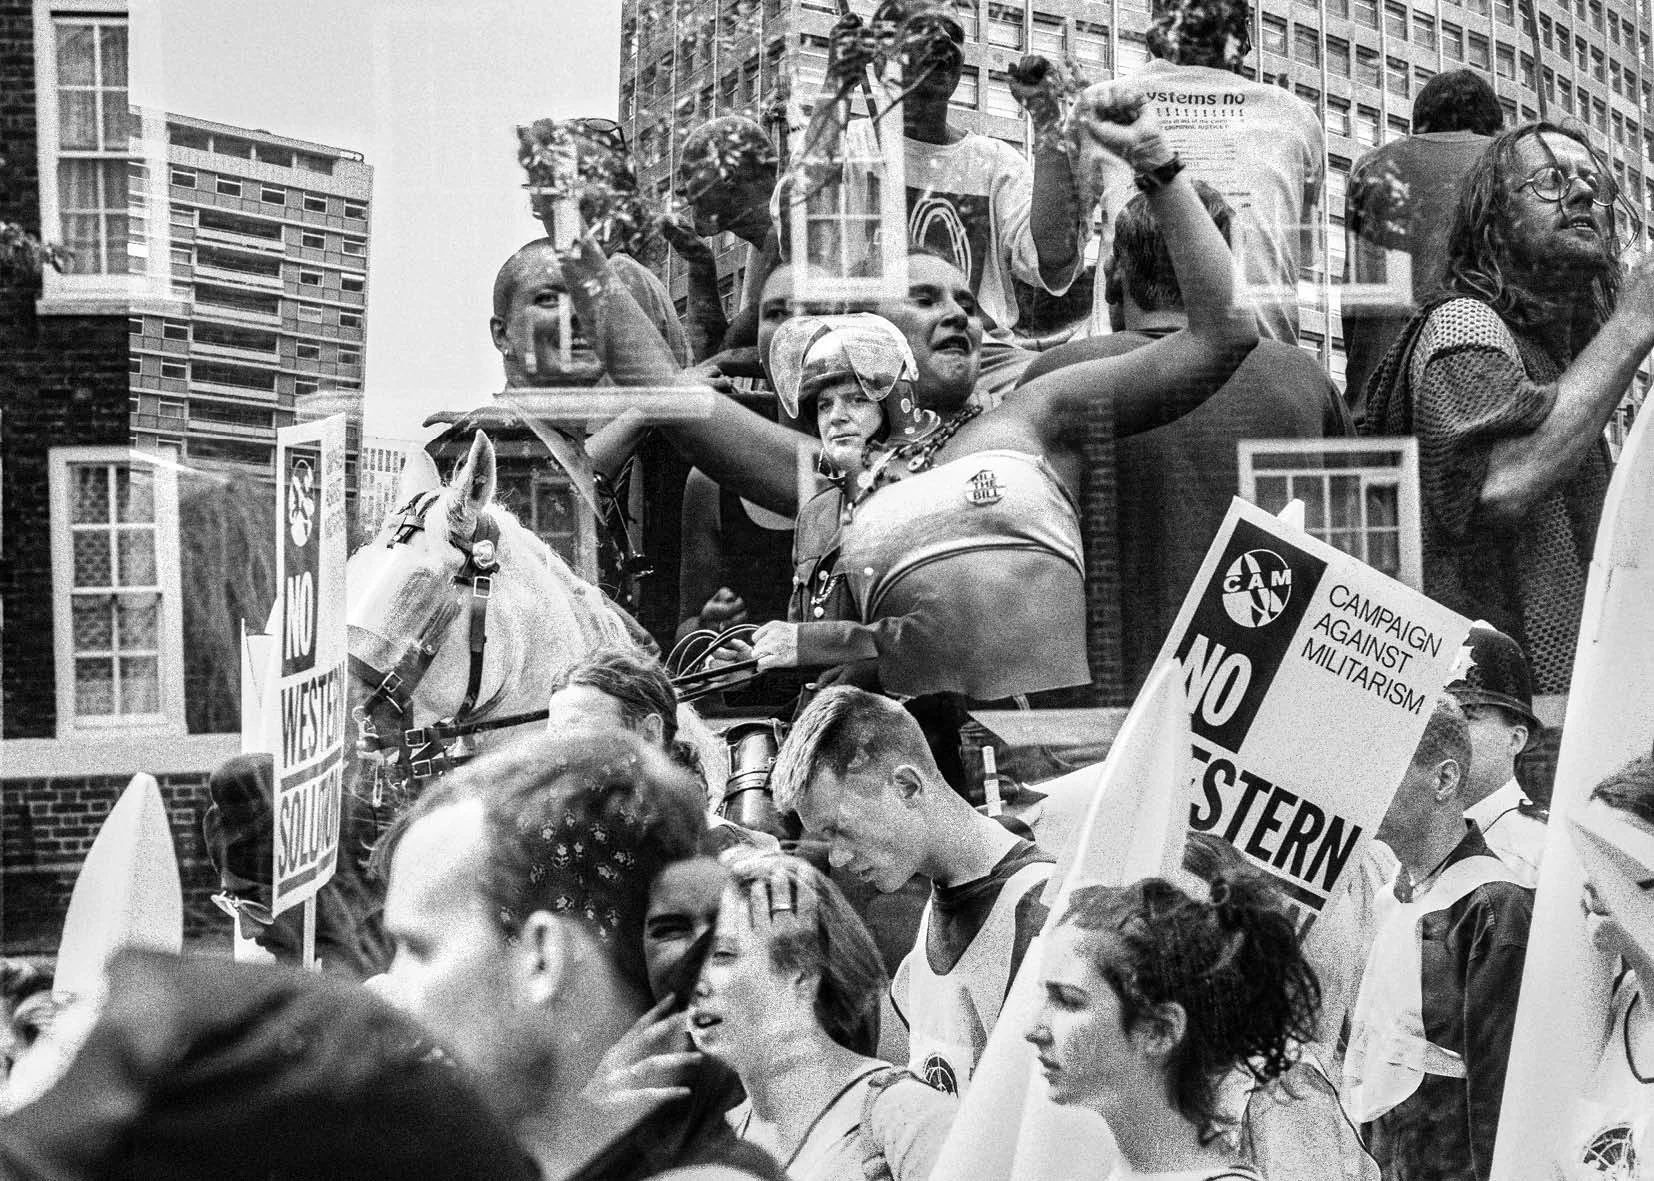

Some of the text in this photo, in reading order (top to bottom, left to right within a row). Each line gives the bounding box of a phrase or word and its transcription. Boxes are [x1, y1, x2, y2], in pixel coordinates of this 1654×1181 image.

[1146, 92, 1246, 105] ystems no
[973, 488, 1000, 500] BILL
[285, 571, 314, 661] NO
[1223, 568, 1292, 593] CAM
[1313, 612, 1413, 673] AGAINST
[1329, 584, 1442, 658] CAMPAIGN
[1181, 633, 1253, 727] NO
[1301, 637, 1425, 715] MILITARISM
[1189, 744, 1363, 893] STERN
